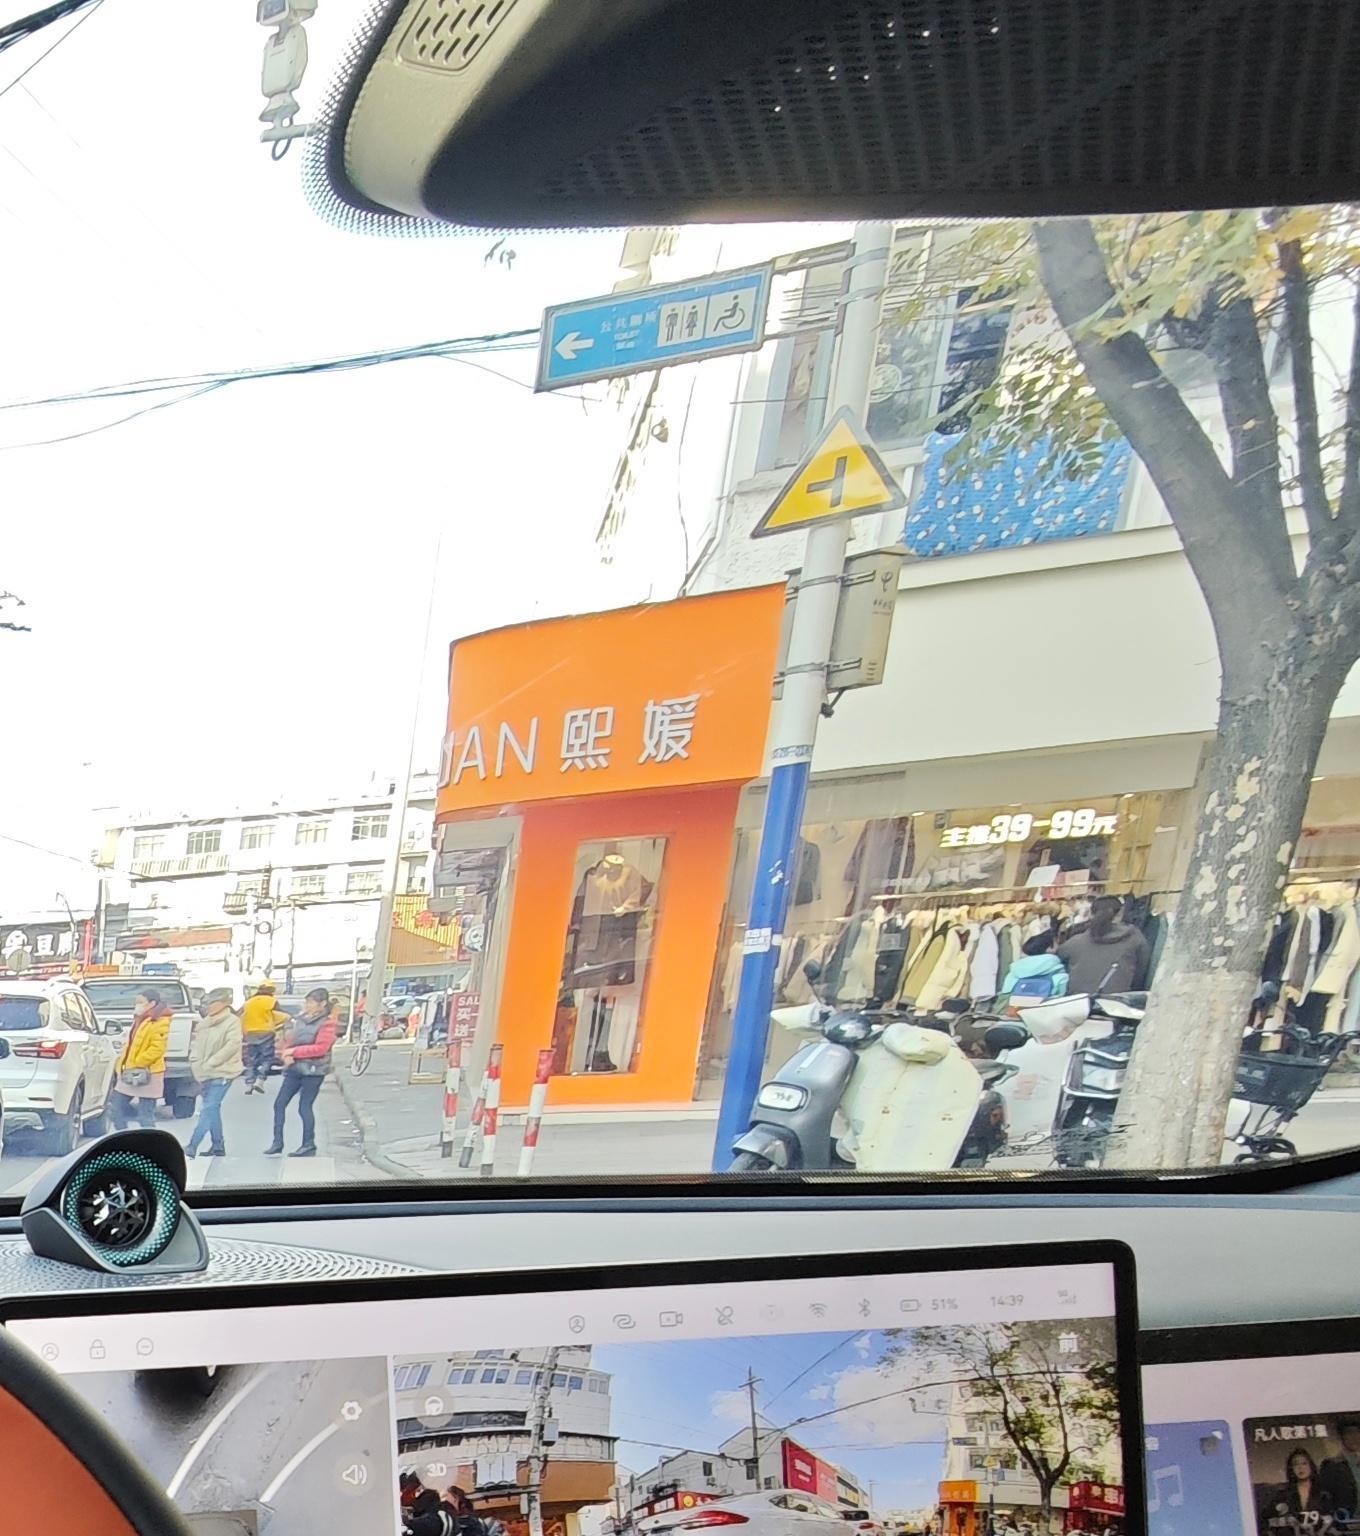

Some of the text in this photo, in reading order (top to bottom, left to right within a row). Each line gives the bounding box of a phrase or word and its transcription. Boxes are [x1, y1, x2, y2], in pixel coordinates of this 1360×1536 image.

[559, 693, 701, 773] 熙媛
[932, 1298, 958, 1310] 51%
[991, 1295, 1025, 1307] 14:39
[426, 1463, 447, 1477] 3D
